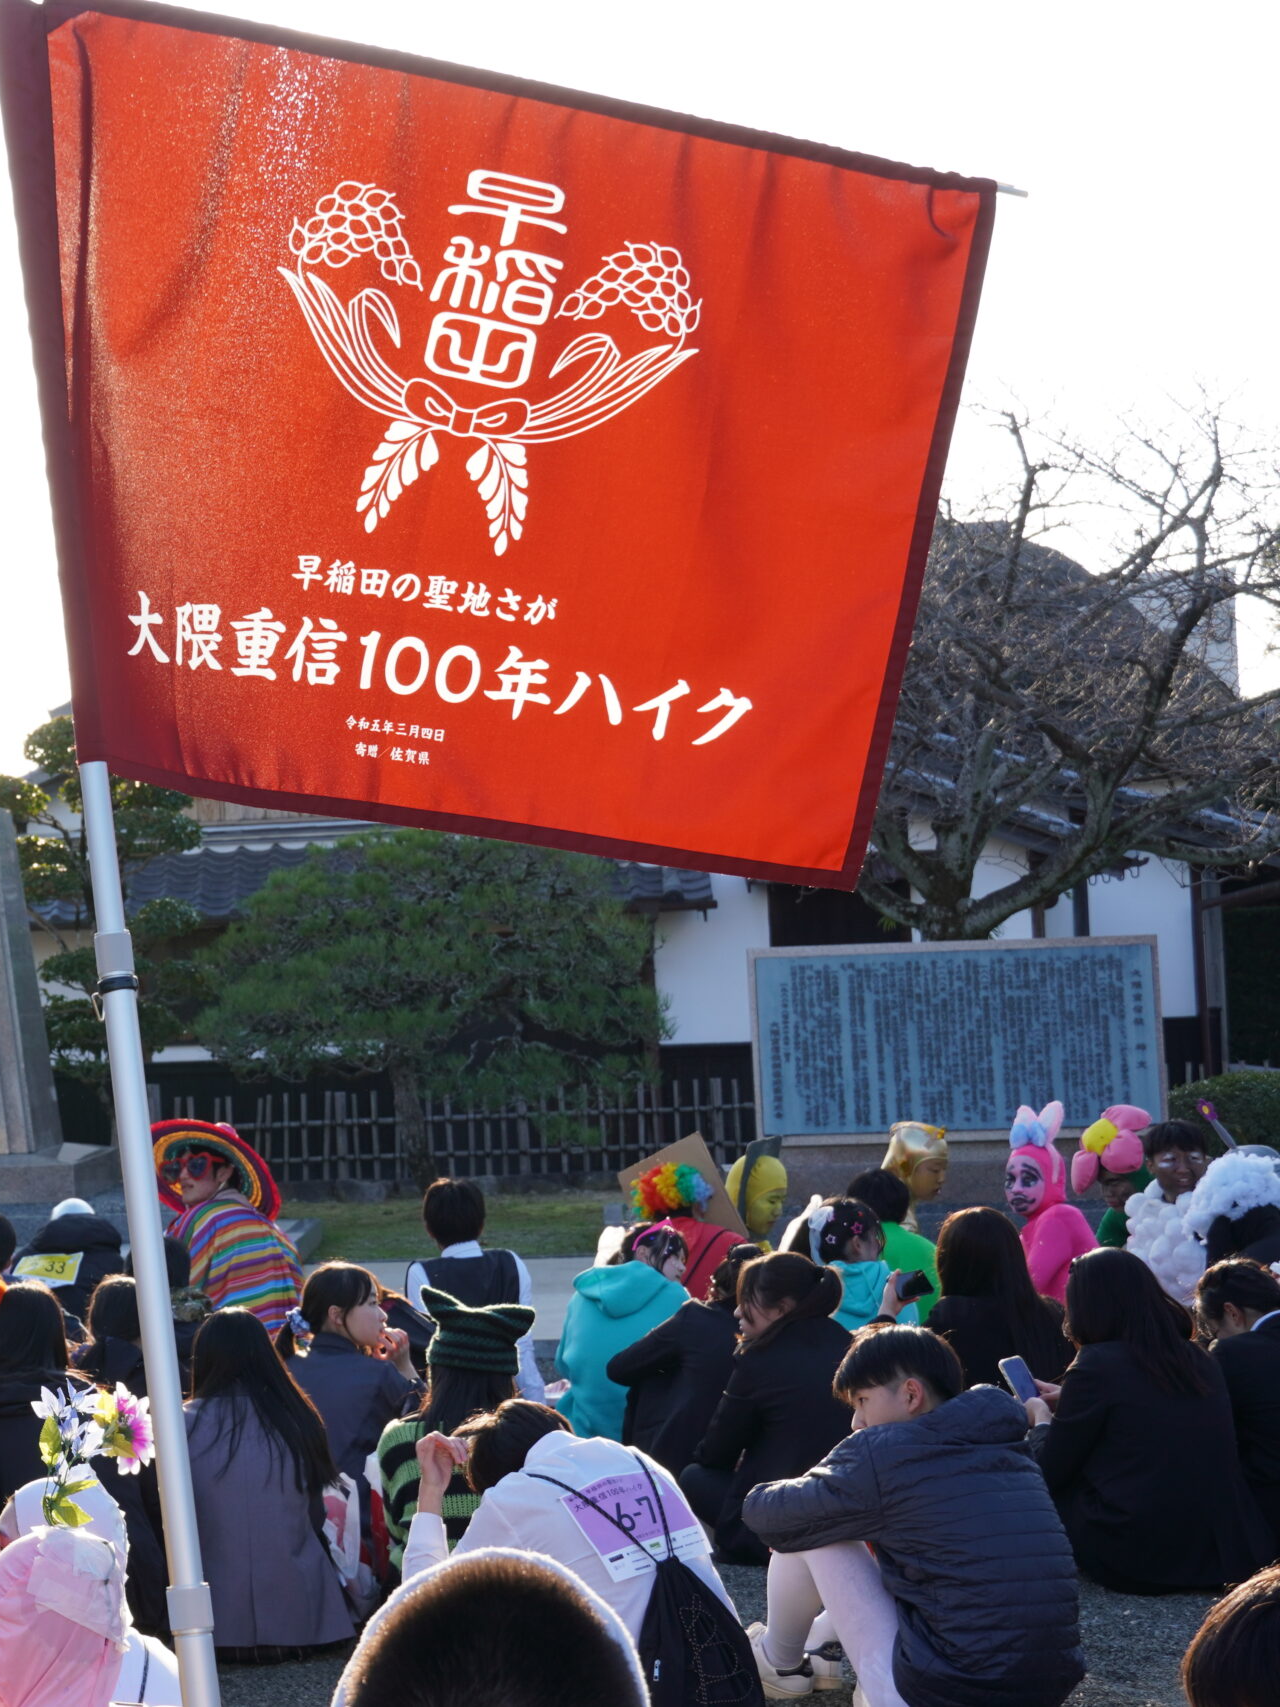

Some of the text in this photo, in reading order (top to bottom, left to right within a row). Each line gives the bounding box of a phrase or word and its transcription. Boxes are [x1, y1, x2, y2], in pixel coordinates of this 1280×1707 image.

[291, 554, 559, 626] 早稲田の聖地さが
[126, 590, 754, 746] 大隈重信100年ハイク
[345, 714, 446, 743] 令和五年三月四日
[615, 1495, 658, 1532] 6-7
